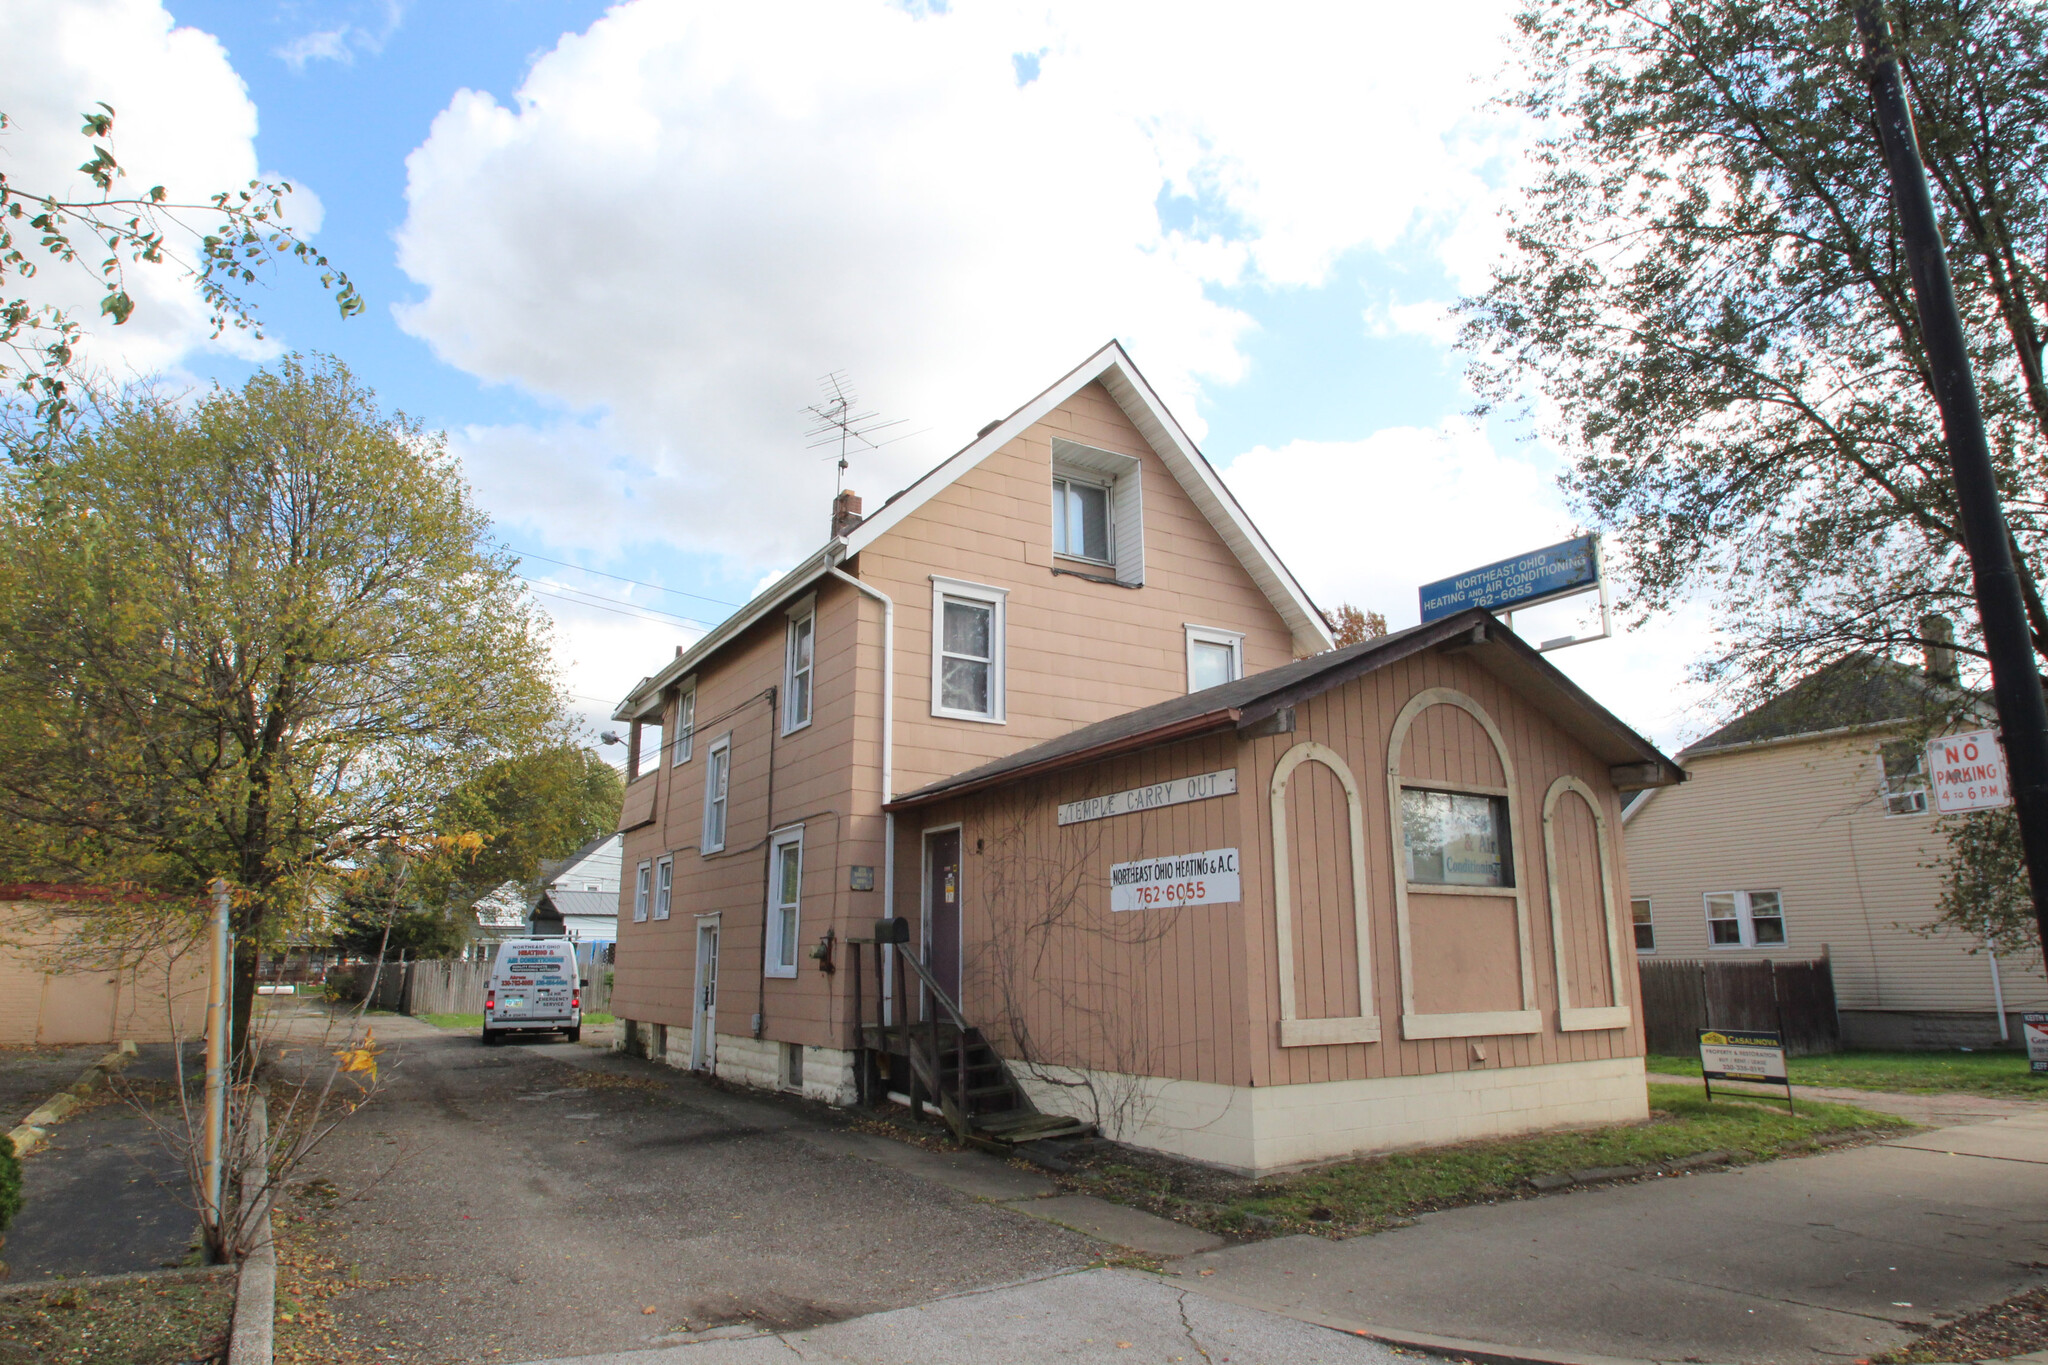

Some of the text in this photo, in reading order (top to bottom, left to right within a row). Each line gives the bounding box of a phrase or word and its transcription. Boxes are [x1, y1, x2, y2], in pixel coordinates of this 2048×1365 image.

[1424, 556, 1586, 611] HEATING AND AIR CONDITIONING
[1456, 555, 1546, 590] NORTHEAST OHIO
[1472, 583, 1533, 607] 762-6055
[1945, 743, 1978, 764] NO
[1936, 763, 1997, 785] PARKING
[1068, 774, 1217, 821] TEMPLE CARRY OUT
[1942, 790, 1950, 801] 4
[1968, 787, 1976, 799] 6
[1113, 855, 1236, 885] NORTHEAST OHIO HEATING & A.C.
[1446, 857, 1499, 877] Conditioning
